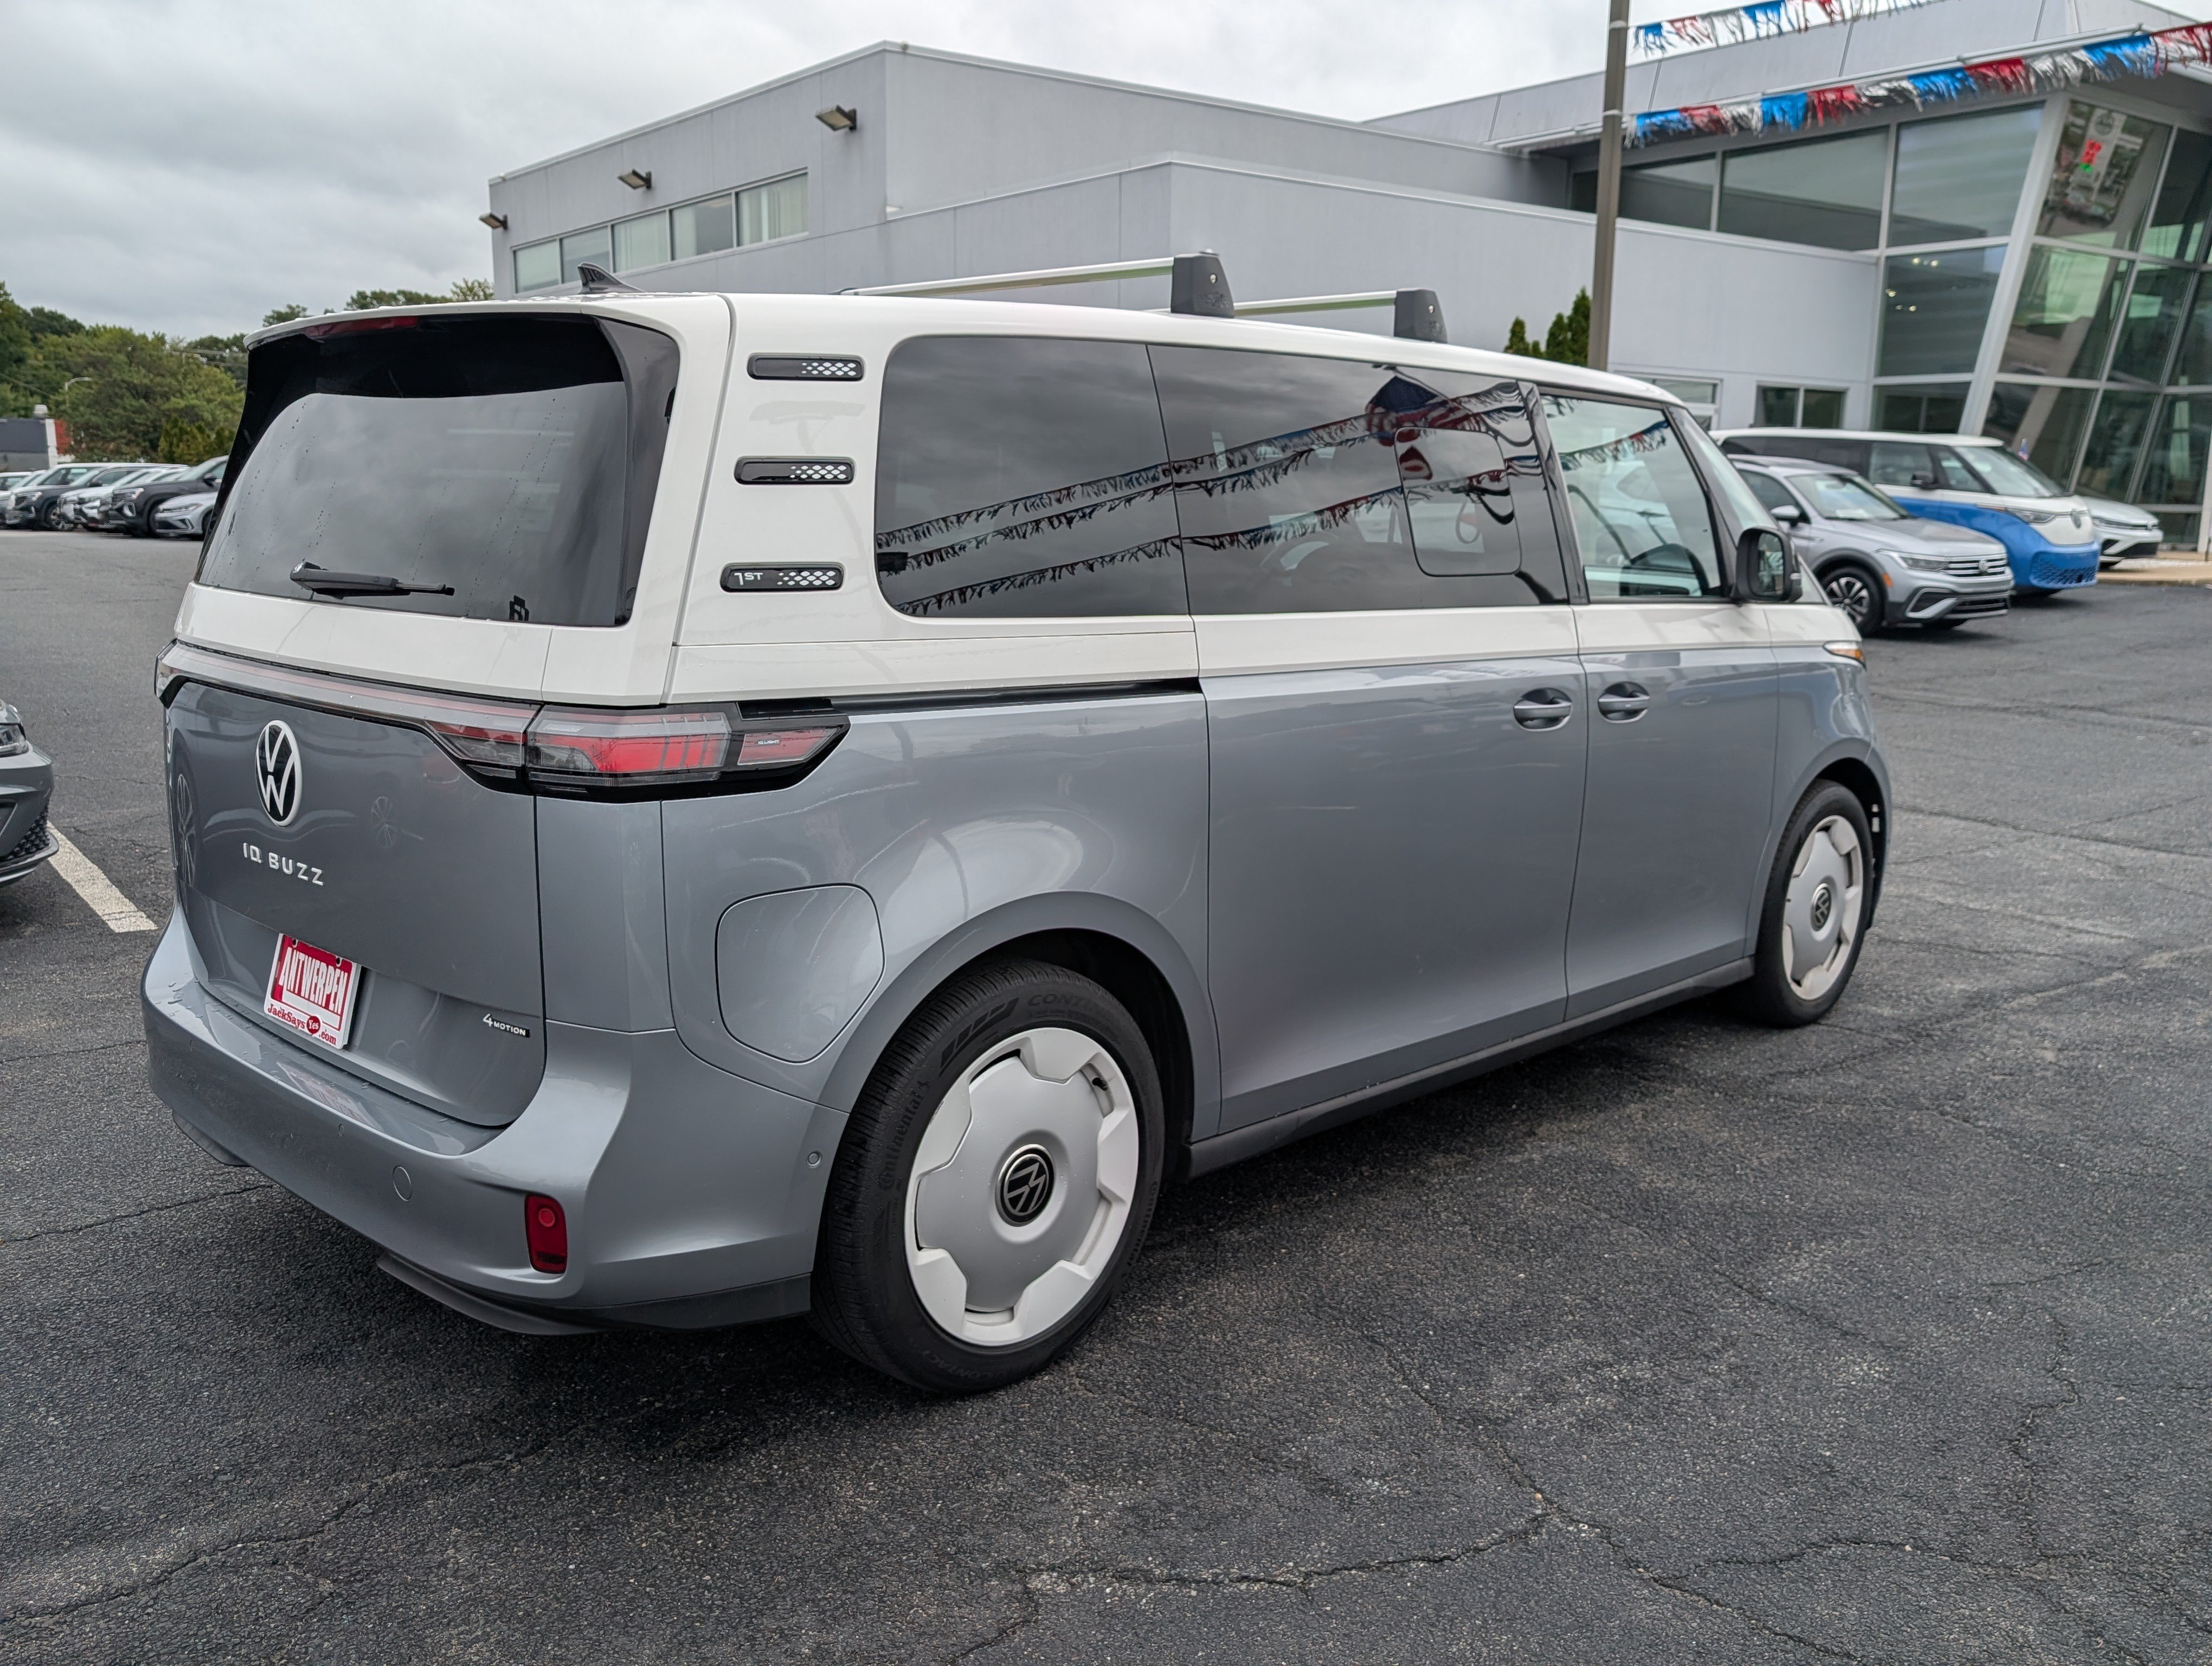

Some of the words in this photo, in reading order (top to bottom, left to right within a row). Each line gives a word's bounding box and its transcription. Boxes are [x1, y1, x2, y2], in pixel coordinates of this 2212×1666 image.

[734, 572, 764, 586] 1ST
[268, 852, 324, 886] BUZZ
[278, 946, 348, 1015] ANTWERPEN
[267, 1003, 306, 1029] JackSays
[308, 1019, 319, 1030] Yes
